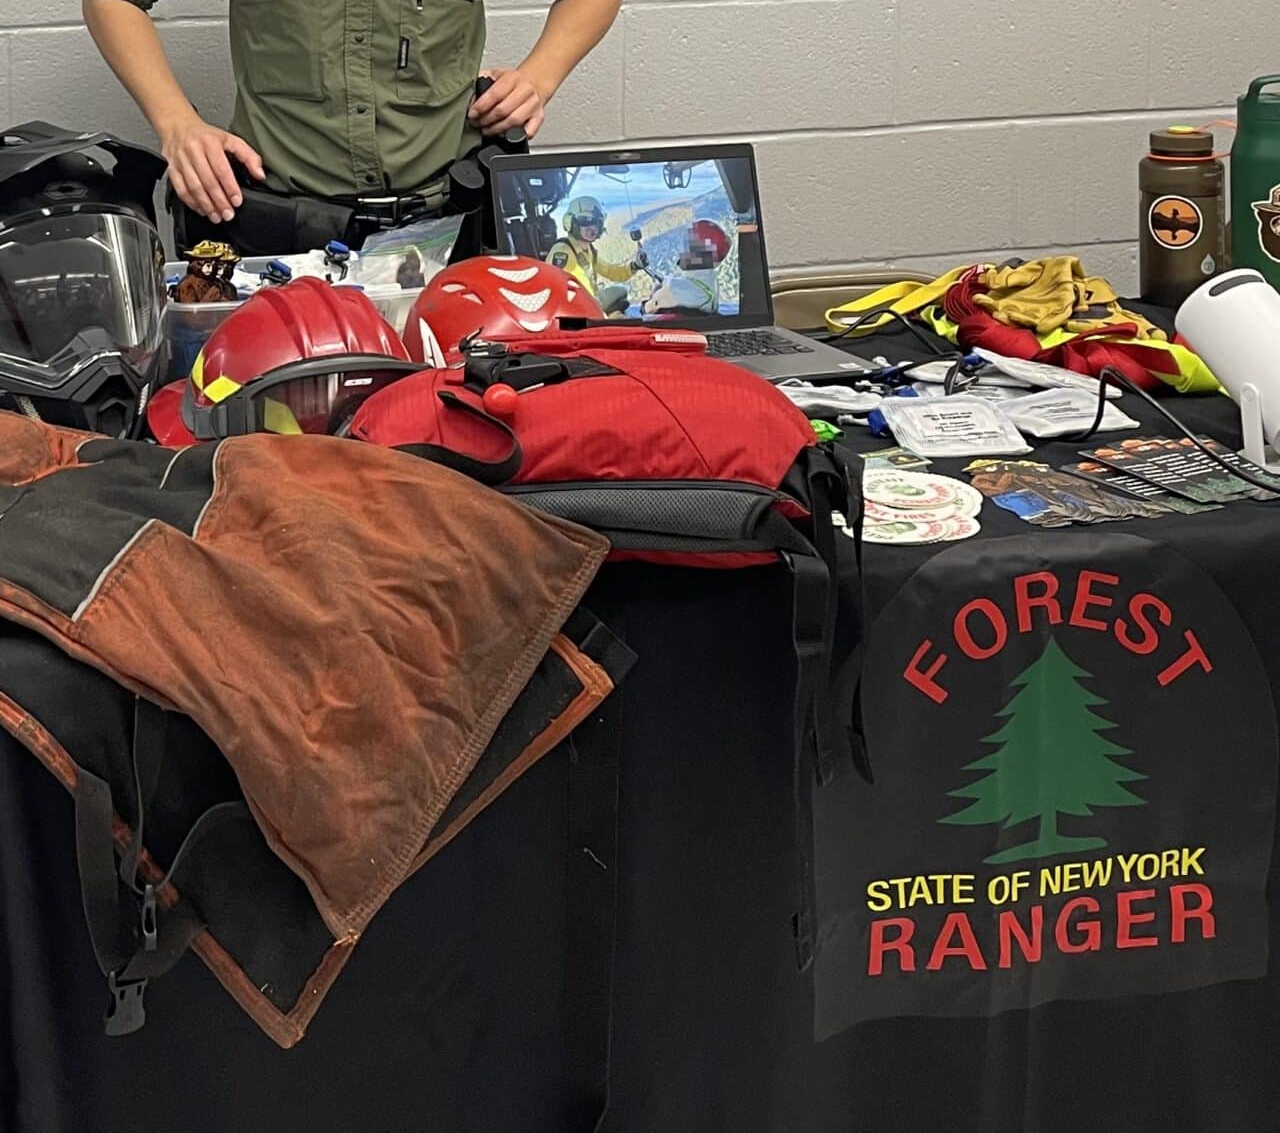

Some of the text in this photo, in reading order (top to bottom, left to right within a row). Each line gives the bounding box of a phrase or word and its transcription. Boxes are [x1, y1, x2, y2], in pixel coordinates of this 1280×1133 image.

[903, 570, 1213, 705] FOREST
[867, 847, 1207, 912] STATE OF NEW YORK
[866, 882, 1218, 977] RANGER
